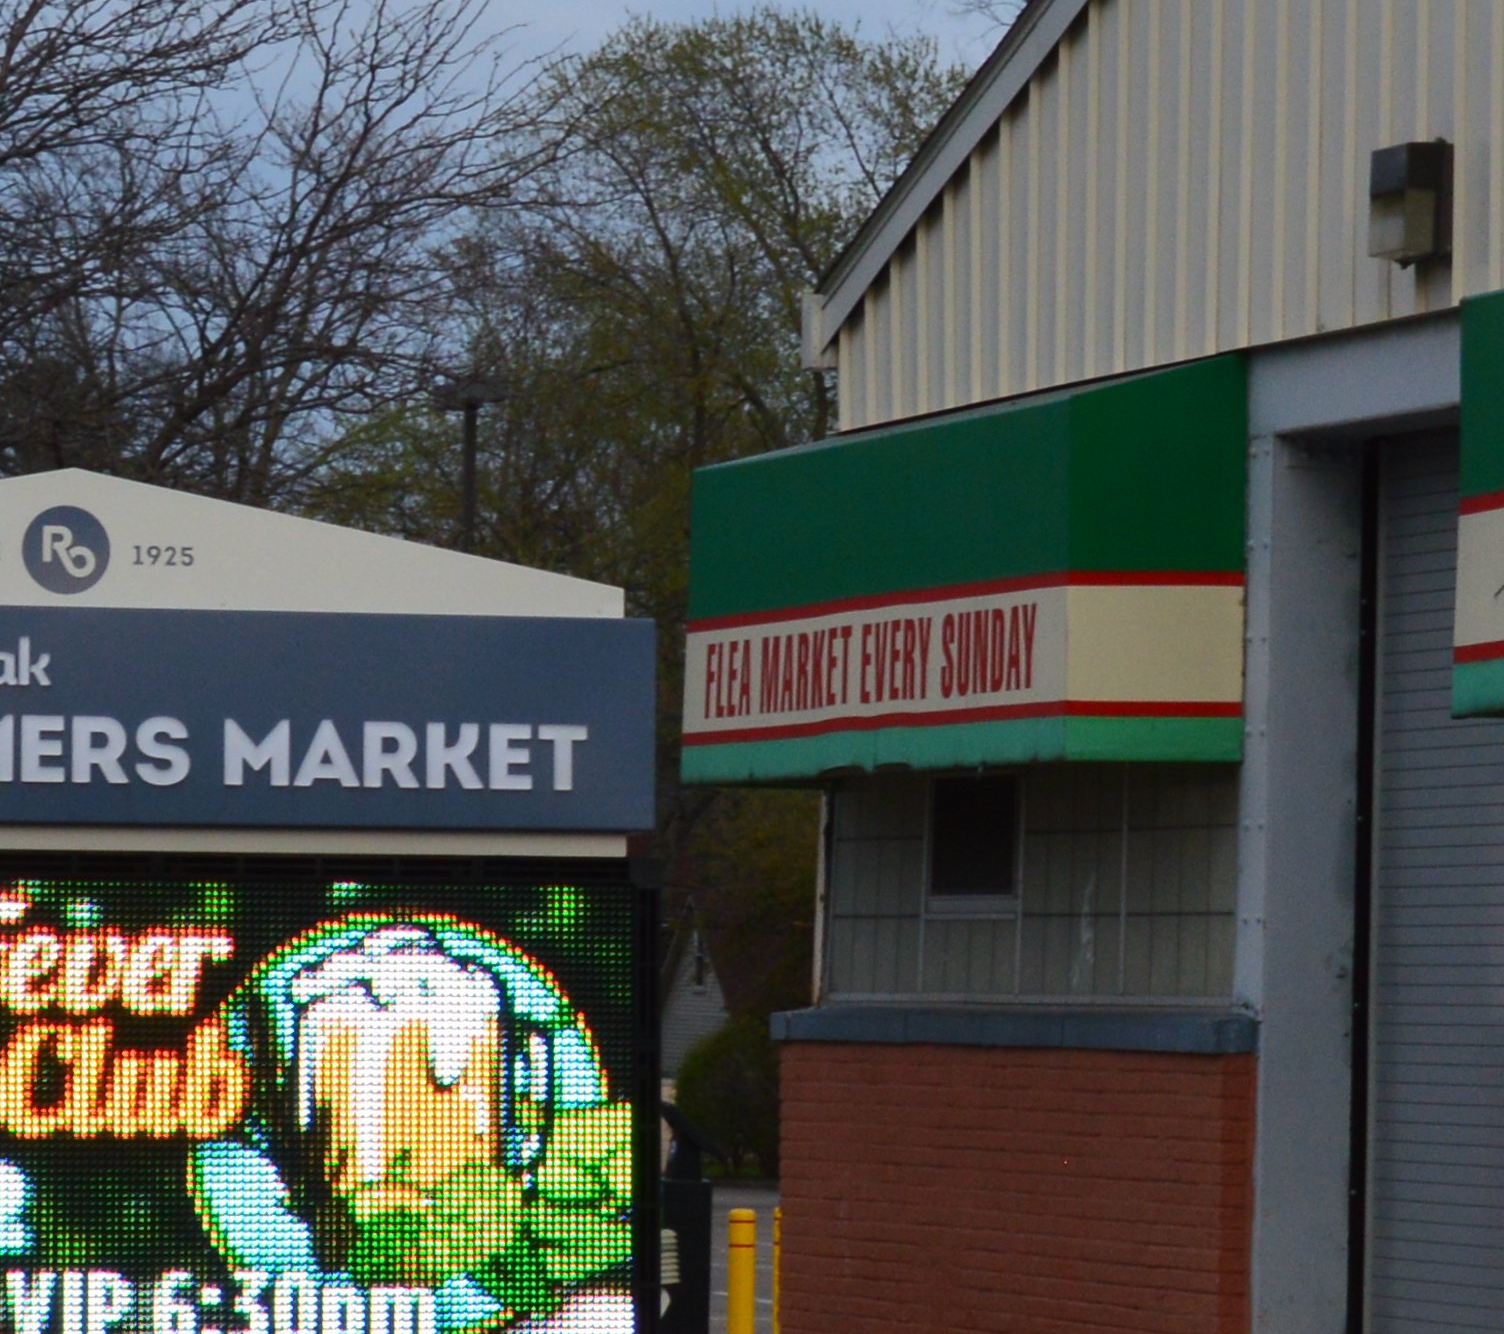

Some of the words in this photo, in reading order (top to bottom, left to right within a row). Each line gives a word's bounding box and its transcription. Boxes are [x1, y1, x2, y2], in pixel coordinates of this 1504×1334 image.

[132, 544, 195, 568] 1925
[704, 640, 751, 718] FLEA
[760, 625, 852, 714] MARKET
[859, 617, 932, 704] EVERY
[940, 603, 1037, 698] SUNDAY
[223, 718, 588, 791] MARKET
